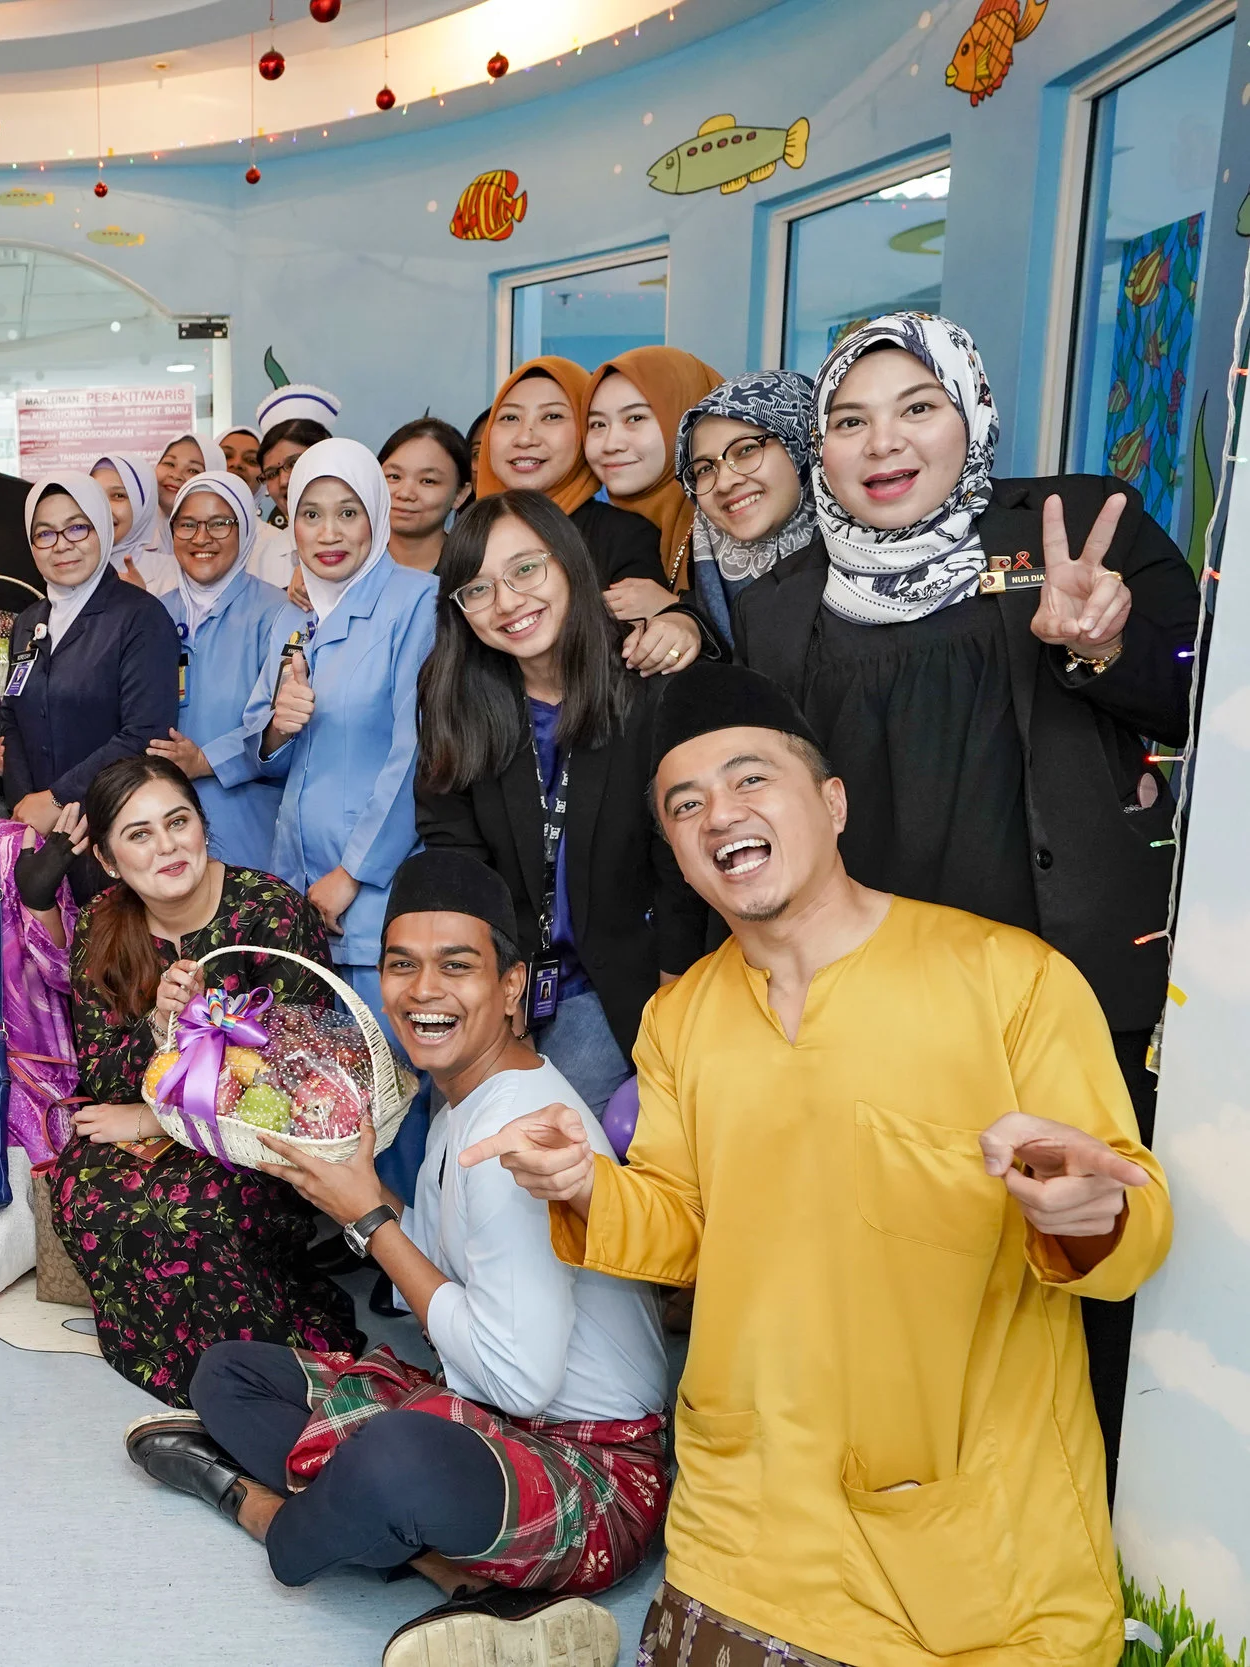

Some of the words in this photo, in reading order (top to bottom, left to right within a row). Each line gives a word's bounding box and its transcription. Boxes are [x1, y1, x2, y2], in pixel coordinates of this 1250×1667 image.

[25, 395, 79, 406] MAKLUMAN
[86, 389, 185, 403] PESAKIT/WARIS
[1011, 575, 1029, 584] NUR
[1031, 574, 1047, 582] DIA
